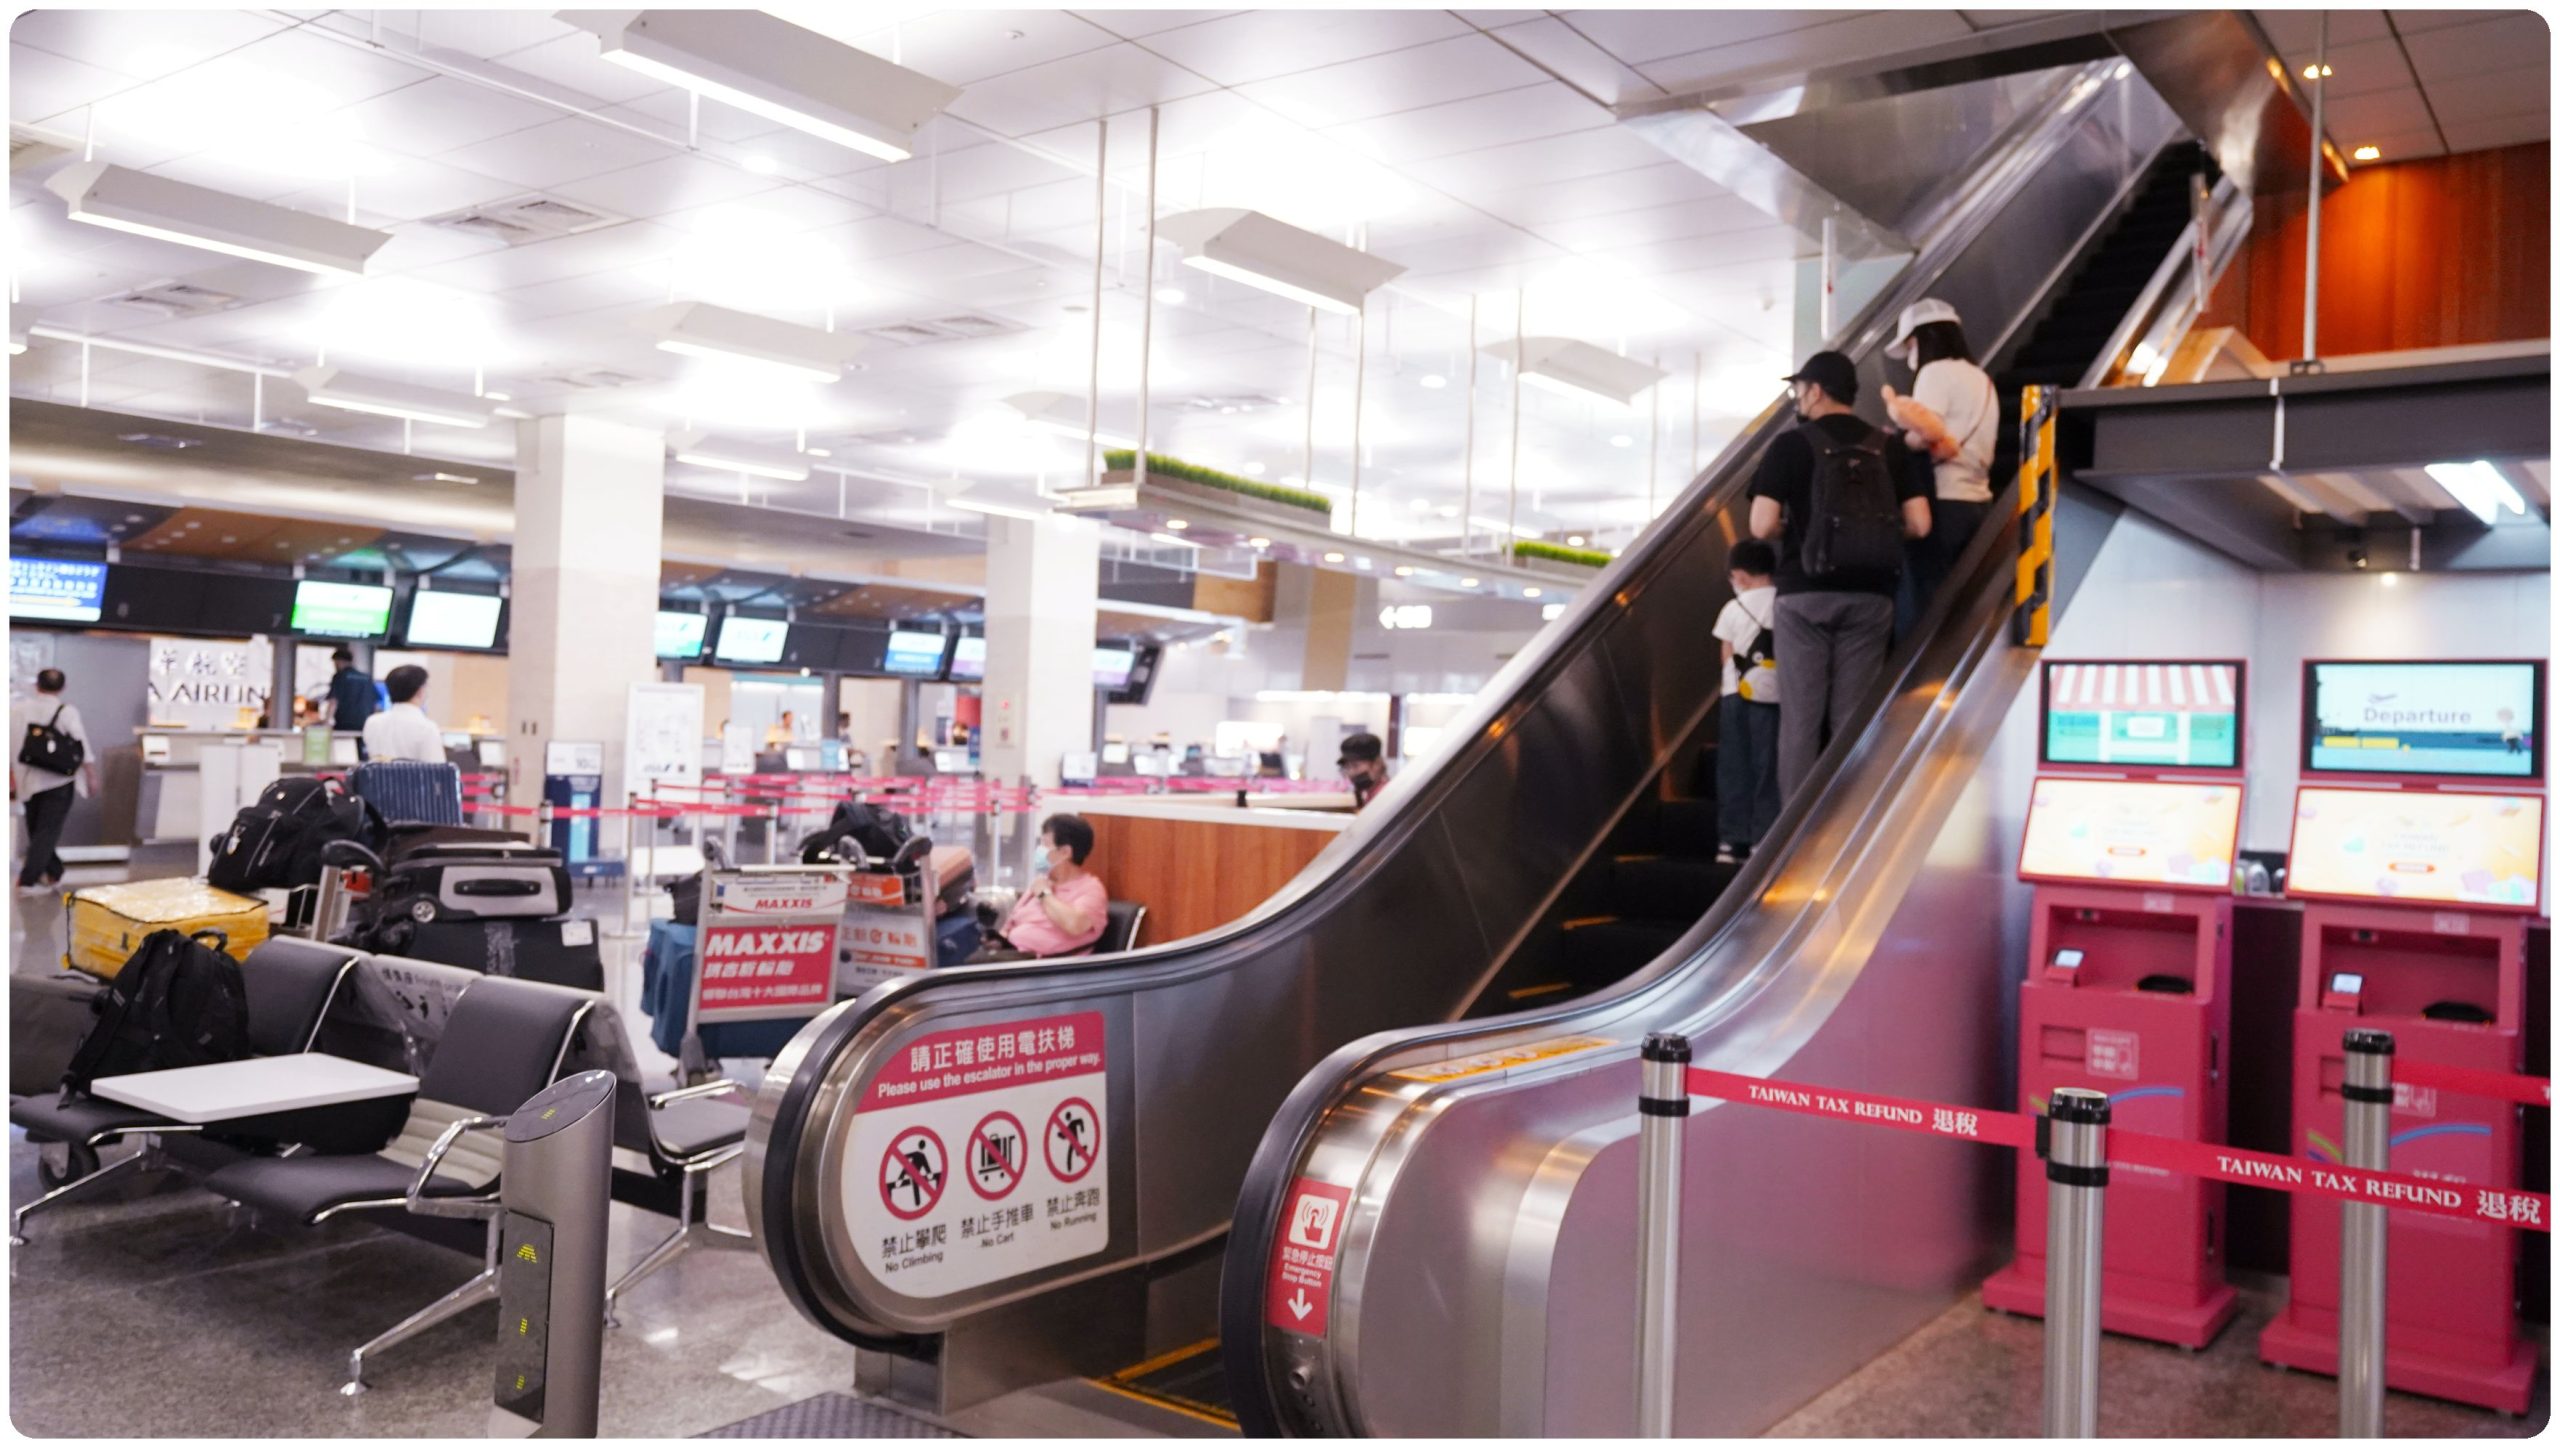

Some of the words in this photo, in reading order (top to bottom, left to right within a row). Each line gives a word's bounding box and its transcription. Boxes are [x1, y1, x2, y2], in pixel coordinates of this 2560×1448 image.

[2364, 708, 2472, 726] Departure
[755, 898, 813, 910] MAXXIS
[705, 931, 826, 957] MAXXIS
[910, 1025, 1075, 1073] 請正確使用電扶梯
[878, 1080, 917, 1098] Please
[920, 1076, 941, 1091] use
[943, 1072, 961, 1087] the
[963, 1063, 1012, 1085] escalator
[1014, 1061, 1024, 1075] in
[1027, 1058, 1043, 1072] the
[1045, 1054, 1078, 1074] proper
[1080, 1053, 1101, 1068] way.
[1748, 1085, 1810, 1107] TAIWAN
[1816, 1095, 1849, 1114] TAX
[1854, 1101, 1923, 1125] REFUND
[1932, 1108, 1978, 1136] 退稅
[1047, 1187, 1101, 1218] 禁止奔跑
[2217, 1155, 2302, 1183] TAIWAN
[2311, 1170, 2356, 1193] TAX
[2366, 1179, 2462, 1209] REFUND
[2477, 1189, 2542, 1225] 退稅
[961, 1203, 1034, 1239] 禁止手推車
[1050, 1220, 1062, 1231] No
[1064, 1211, 1097, 1229] Running
[882, 1224, 947, 1259] 禁止攀爬
[981, 1237, 994, 1248] No
[996, 1232, 1015, 1246] Cart
[885, 1261, 899, 1273] No
[902, 1251, 944, 1269] Climbing
[1284, 1263, 1322, 1279] Emergency
[1282, 1271, 1297, 1283] Stop
[1299, 1274, 1322, 1288] Button
